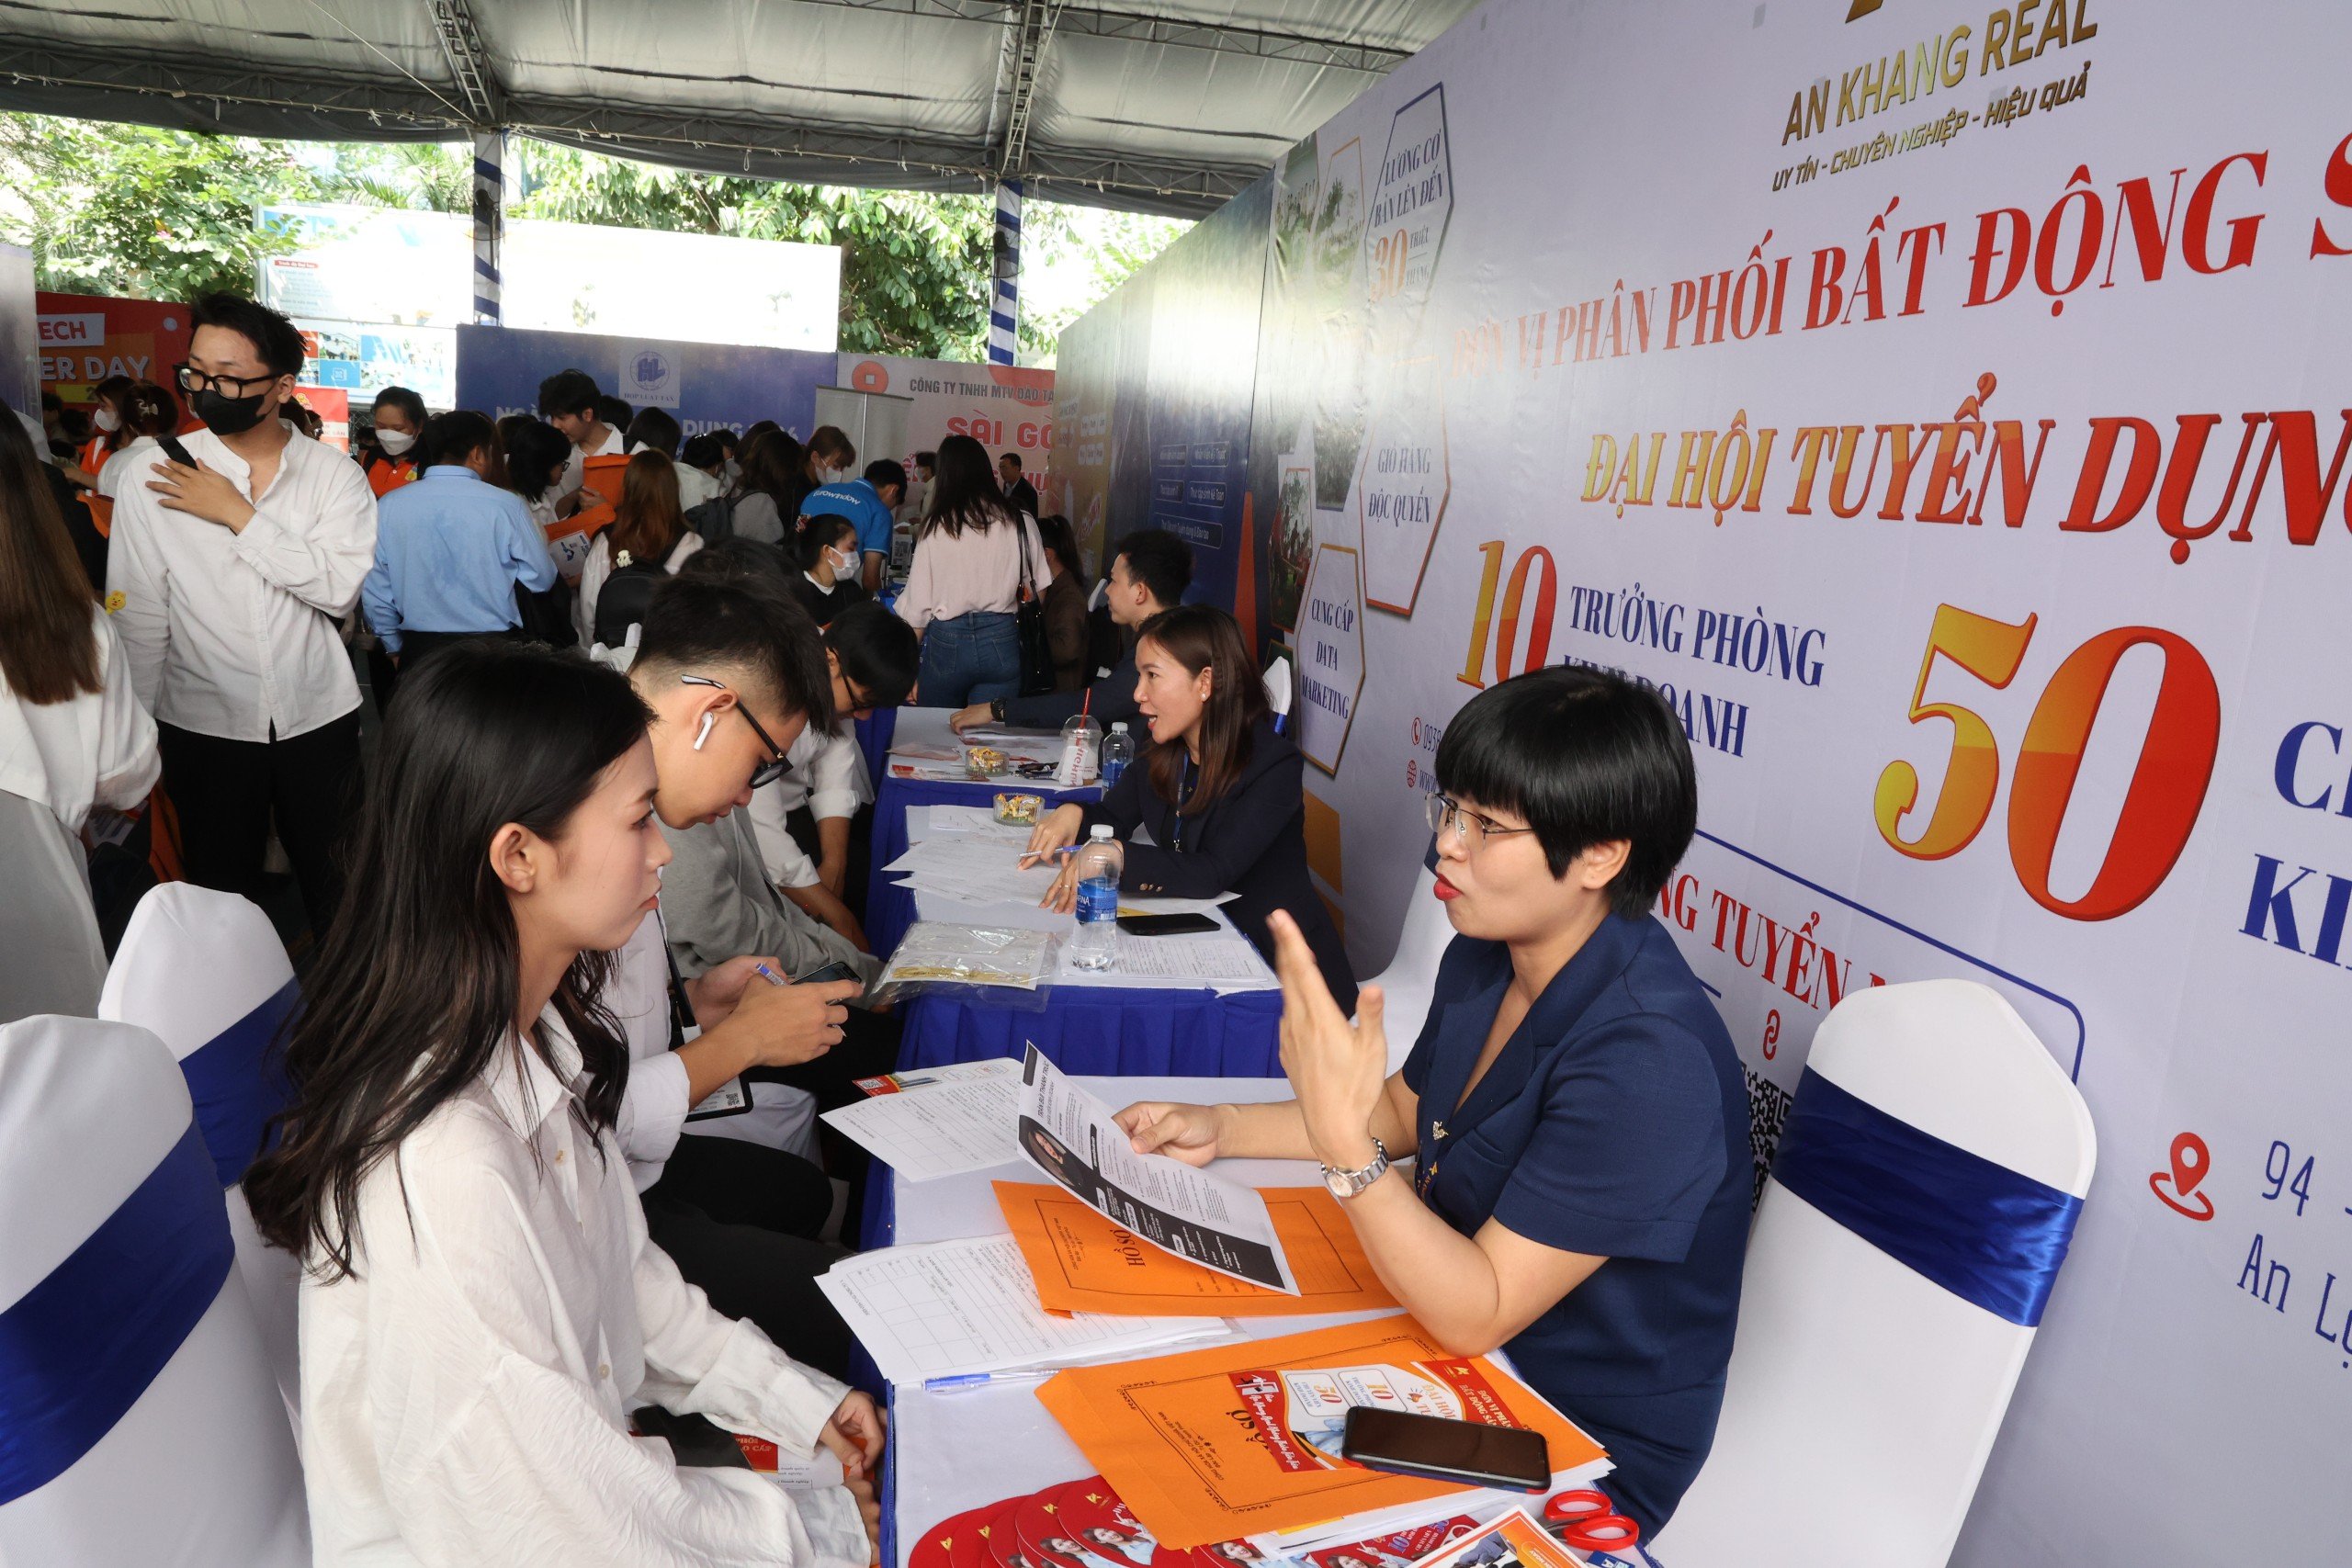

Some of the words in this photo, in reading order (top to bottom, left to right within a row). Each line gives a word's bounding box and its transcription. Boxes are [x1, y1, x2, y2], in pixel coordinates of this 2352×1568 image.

[1782, 79, 1830, 146] AN
[1836, 25, 1972, 128] KHANG
[1980, 0, 2098, 77] REAL
[1385, 144, 1421, 186] LƯƠNG
[1424, 129, 1442, 164] CƠ
[1772, 167, 1792, 191] UY
[1796, 155, 1820, 185] TÍN
[1830, 131, 1897, 175] CHUYÊN
[1897, 107, 1969, 153] NGHIỆP
[1983, 85, 2038, 128] HIỆU
[2039, 61, 2091, 111] QUẢ
[1397, 184, 1417, 218] LÊN
[1419, 164, 1444, 207] ĐẾN
[1369, 229, 1408, 304] 30
[1518, 310, 1548, 382] VỊ
[1552, 278, 1657, 366] PHÂN
[1663, 229, 1792, 350] PHỐI
[1802, 195, 1946, 332] BẤT
[1962, 150, 2268, 318] ĐỘNG
[39, 321, 86, 340] ECH
[40, 356, 76, 380] ER
[85, 355, 149, 380] DAY
[910, 377, 940, 393] CÔNG
[944, 381, 956, 395] TY
[959, 383, 988, 397] TNHH
[991, 386, 1014, 399] MTV
[1042, 389, 1054, 405] TẠ
[945, 409, 1003, 446] SÀI
[1016, 414, 1052, 450] GÒ
[1368, 488, 1391, 523] ĐỘC
[1580, 432, 1667, 519] ĐẠI
[1667, 408, 1778, 527] HỘI
[1787, 371, 2056, 528] TUYỂN
[2058, 409, 2352, 565] DỤN
[1311, 599, 1334, 626] CUNG
[1335, 600, 1353, 632] CẤP
[1456, 539, 1557, 690] 10
[1570, 582, 1684, 653] TRƯỞNG
[1691, 605, 1826, 688] PHÒNG
[1316, 641, 1338, 671] DATA
[1302, 675, 1349, 719] MARKETING
[1635, 674, 1749, 758] OANH
[1873, 603, 2222, 922] 50
[2274, 720, 2352, 818] C
[1654, 868, 1699, 933] NG
[1711, 889, 1852, 1010] TUYỂN
[2238, 852, 2352, 970] KI
[2260, 1139, 2317, 1217] 94
[2235, 1233, 2292, 1314] An
[1314, 1384, 1342, 1403] 50
[1365, 1383, 1394, 1399] 10
